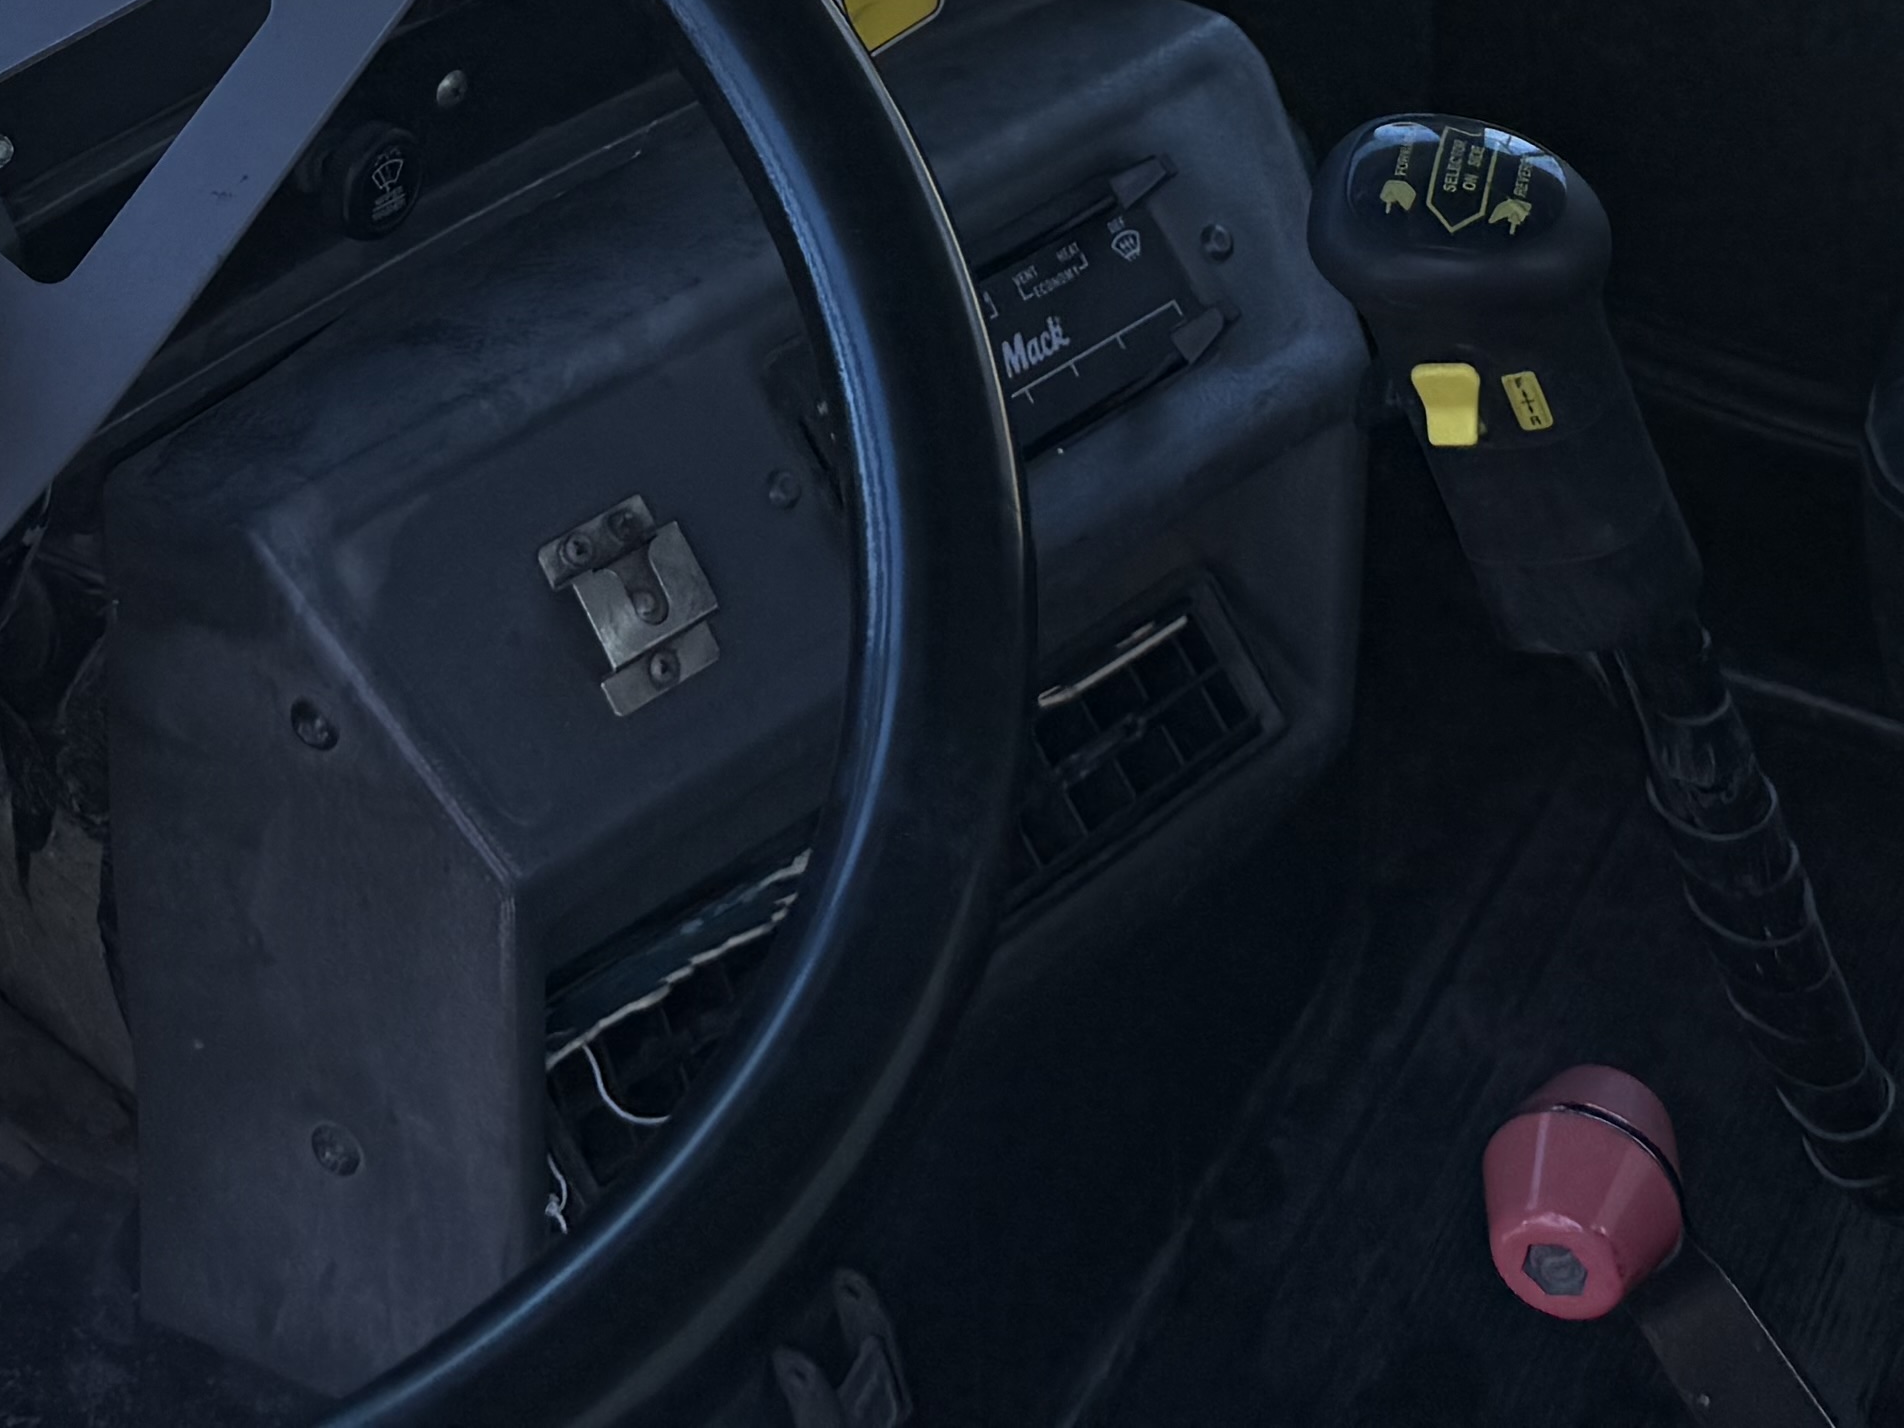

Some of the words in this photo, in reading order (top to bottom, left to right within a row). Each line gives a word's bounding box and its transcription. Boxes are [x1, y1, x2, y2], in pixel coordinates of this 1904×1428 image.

[1443, 139, 1468, 193] SELECTOR
[1468, 145, 1485, 168] SIDE
[1462, 173, 1479, 192] ON
[1012, 264, 1038, 285] VENT
[1055, 240, 1081, 262] HEAT
[1032, 266, 1080, 298] ECONOMY
[1001, 315, 1071, 379] Mack
